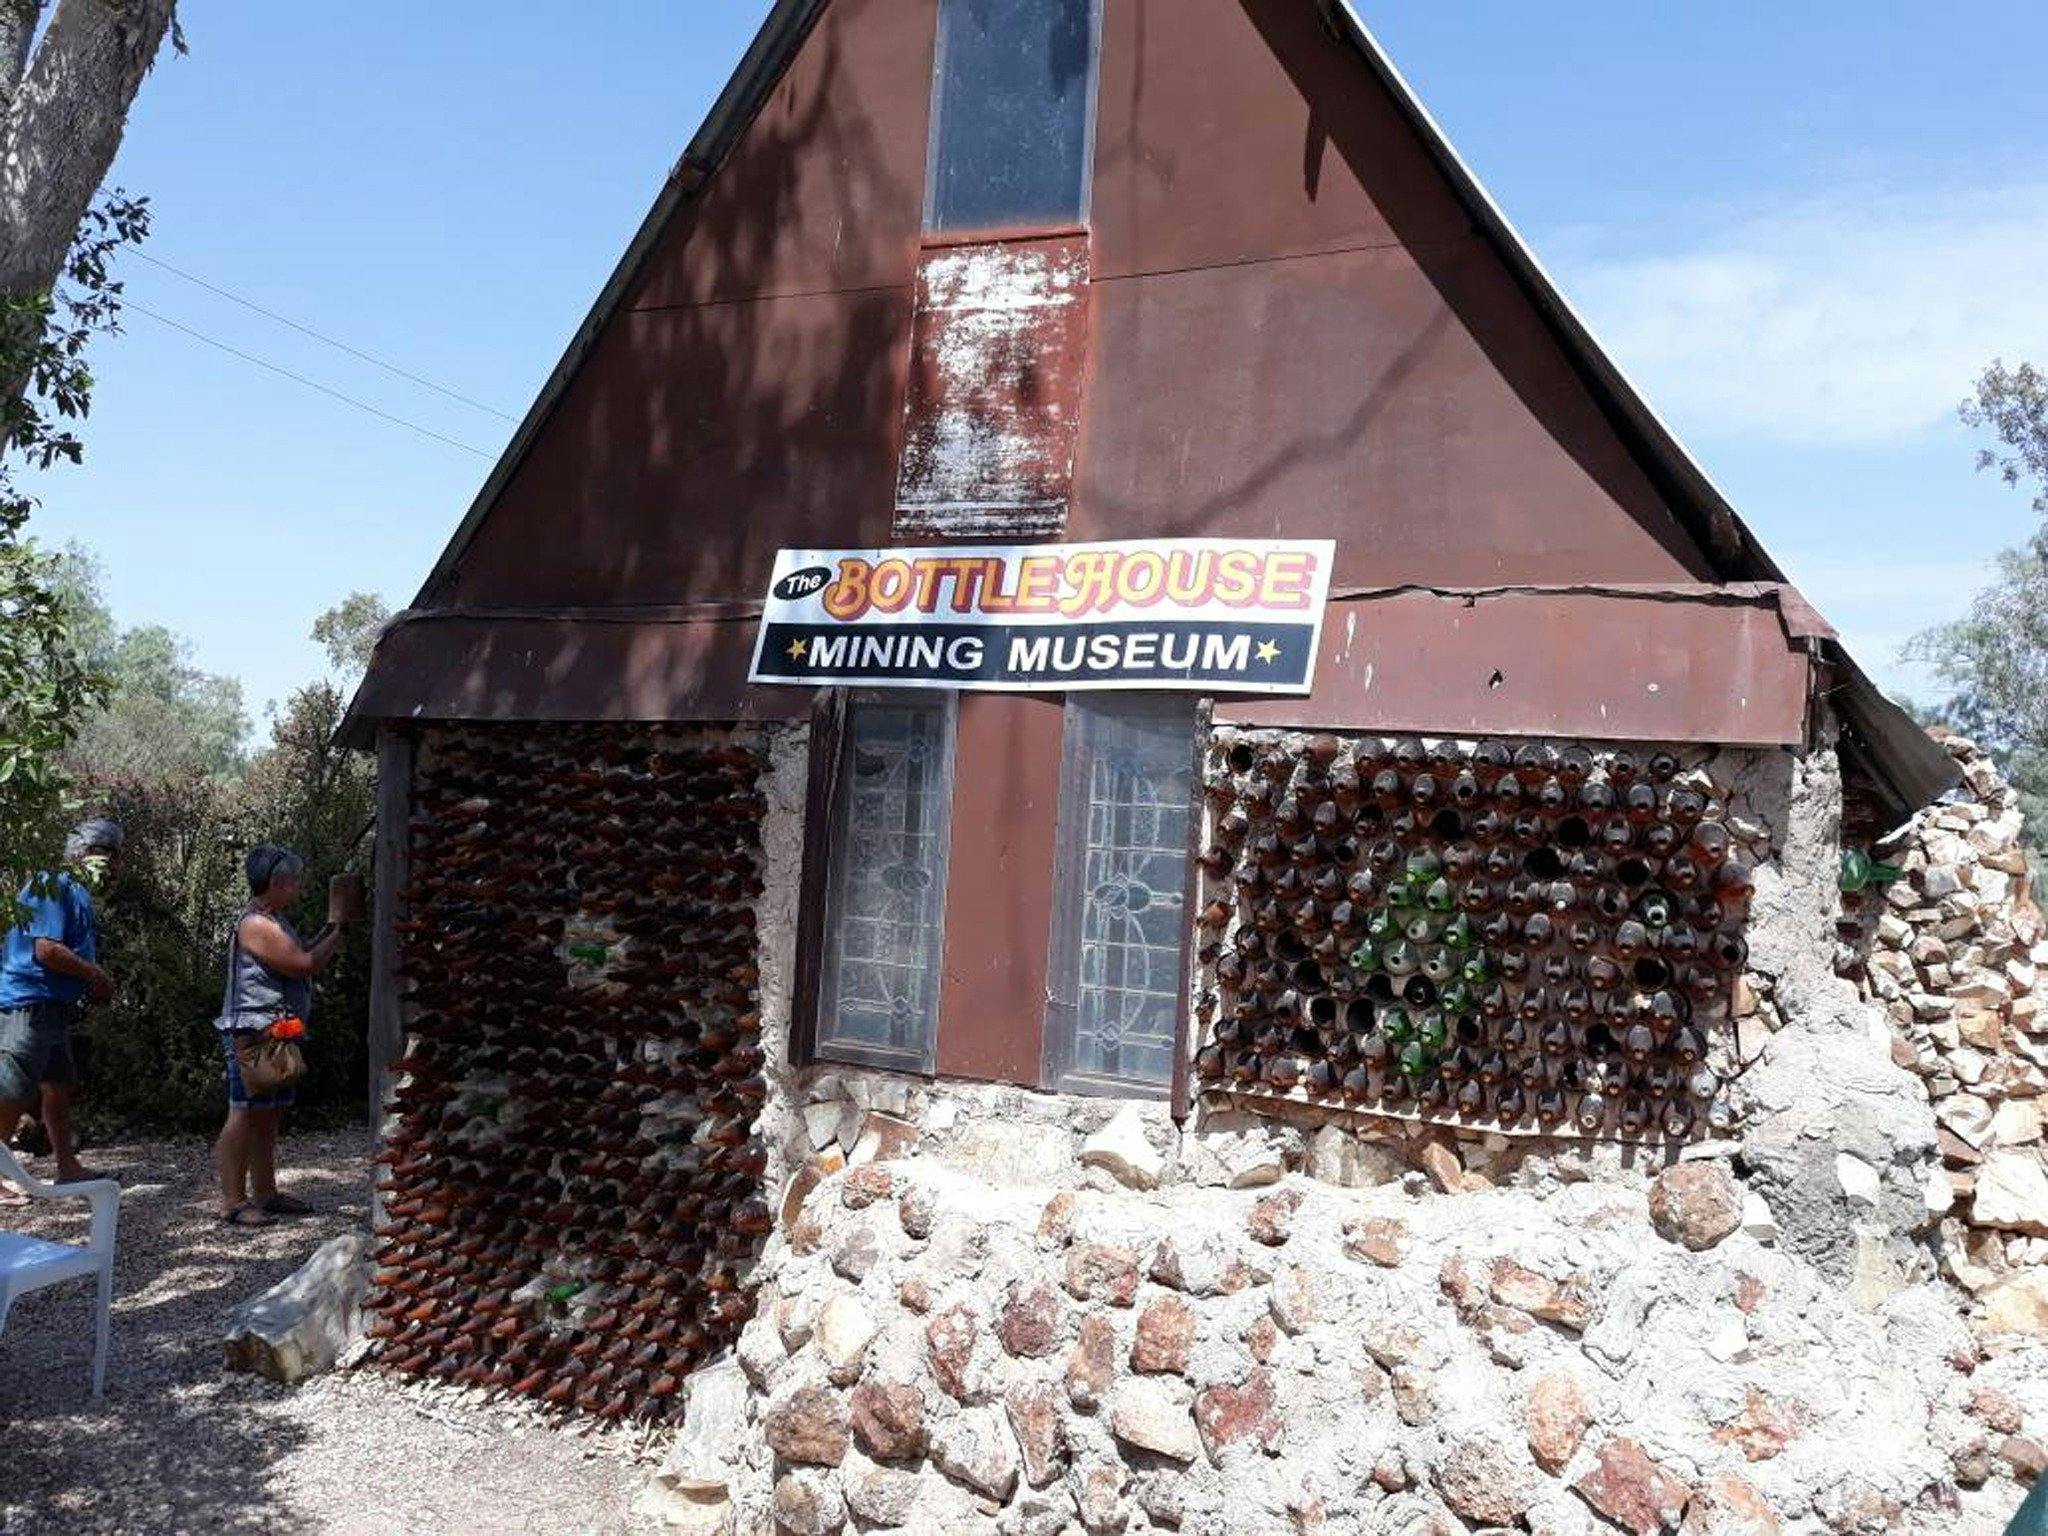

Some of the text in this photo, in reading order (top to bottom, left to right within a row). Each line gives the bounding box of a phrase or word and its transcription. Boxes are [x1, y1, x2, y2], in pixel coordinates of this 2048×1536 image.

[786, 573, 821, 594] The
[808, 634, 1251, 672] MINING MUSEUM
